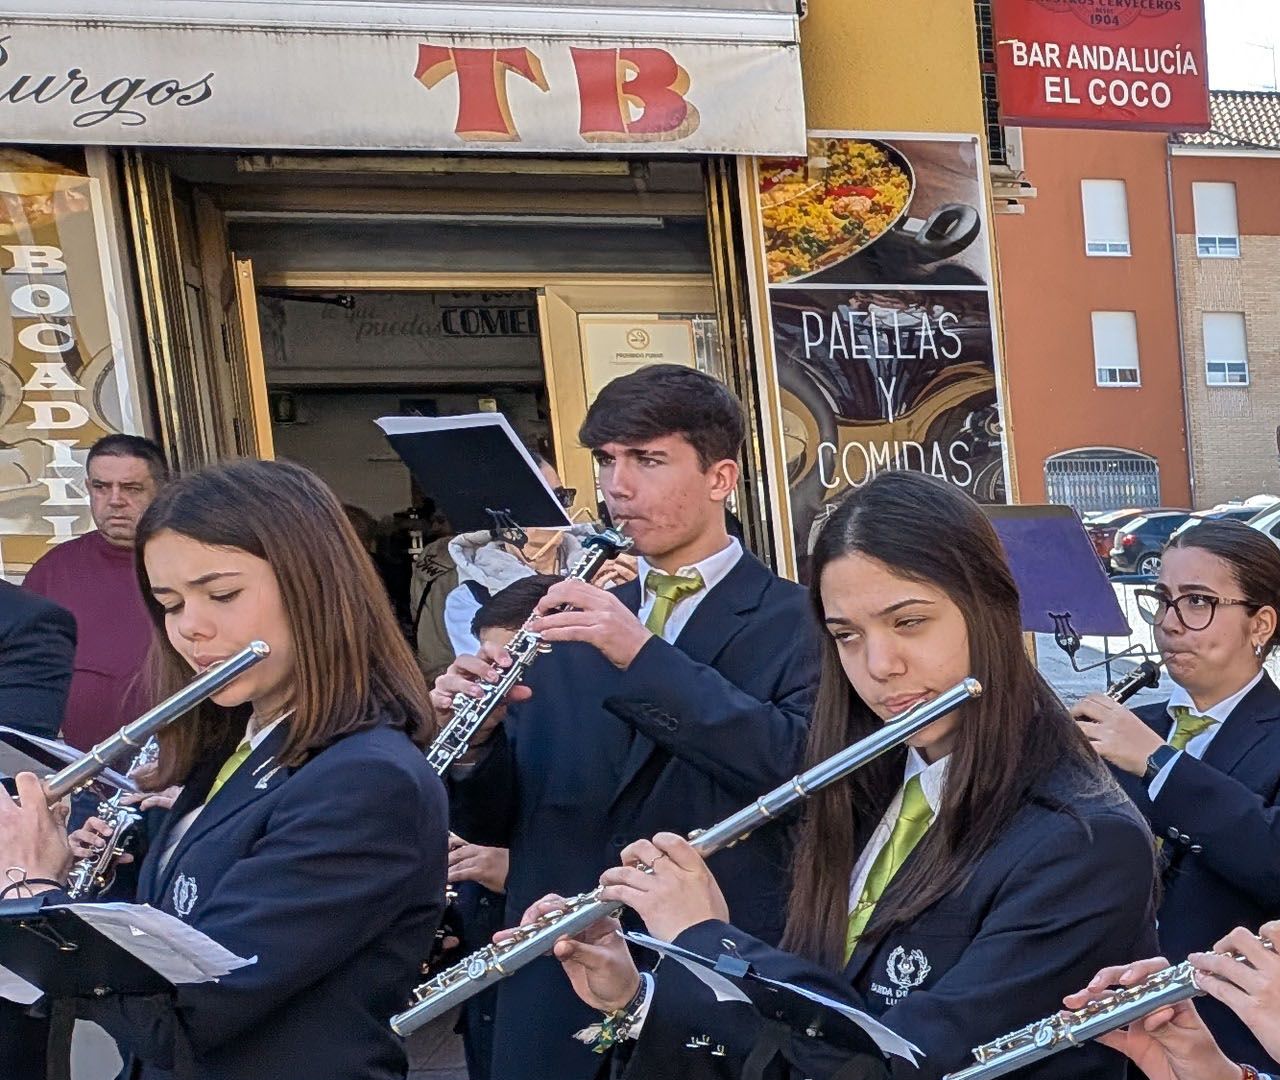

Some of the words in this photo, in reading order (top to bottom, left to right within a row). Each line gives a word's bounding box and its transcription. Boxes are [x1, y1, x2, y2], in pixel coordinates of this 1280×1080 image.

[1090, 14, 1120, 26] 1904
[0, 35, 214, 128] urgos
[1012, 41, 1061, 69] BAR
[1066, 44, 1199, 76] ANDALUCÍA
[1044, 76, 1081, 104] EL
[1088, 79, 1171, 109] COCO
[801, 311, 962, 360] PAELLAS
[878, 376, 897, 423] Y
[817, 441, 973, 489] COMIDAS
